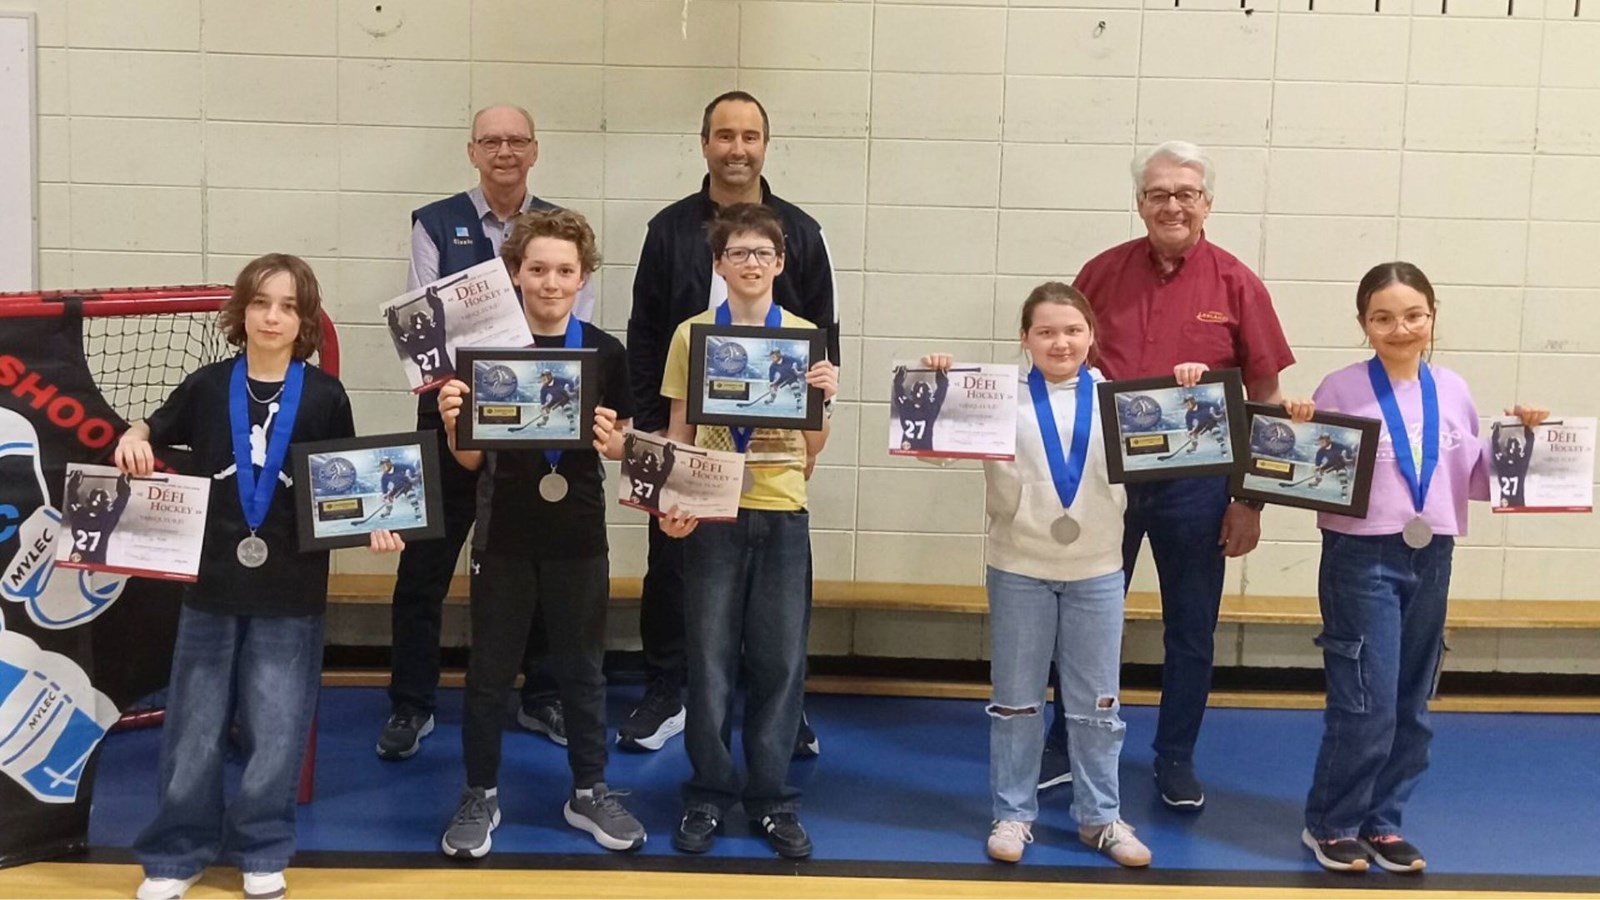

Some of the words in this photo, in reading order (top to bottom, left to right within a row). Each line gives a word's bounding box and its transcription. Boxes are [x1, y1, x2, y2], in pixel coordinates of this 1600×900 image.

[455, 280, 490, 301] DÉFI
[464, 289, 501, 308] HOCKEY
[416, 347, 440, 371] 27
[963, 376, 996, 390] DÉFI
[967, 390, 1005, 400] HOCKEY
[905, 420, 926, 439] 27
[1547, 430, 1576, 442] DÉFI
[689, 457, 722, 473] DÉFI
[692, 470, 730, 481] HOCKEY
[148, 486, 185, 503] DÉFI
[634, 479, 654, 499] 27
[1501, 476, 1519, 496] 27
[150, 502, 193, 514] HOCKEY
[75, 530, 101, 552] 27
[11, 527, 53, 586] MYLEC
[28, 692, 57, 730] MYLEC
